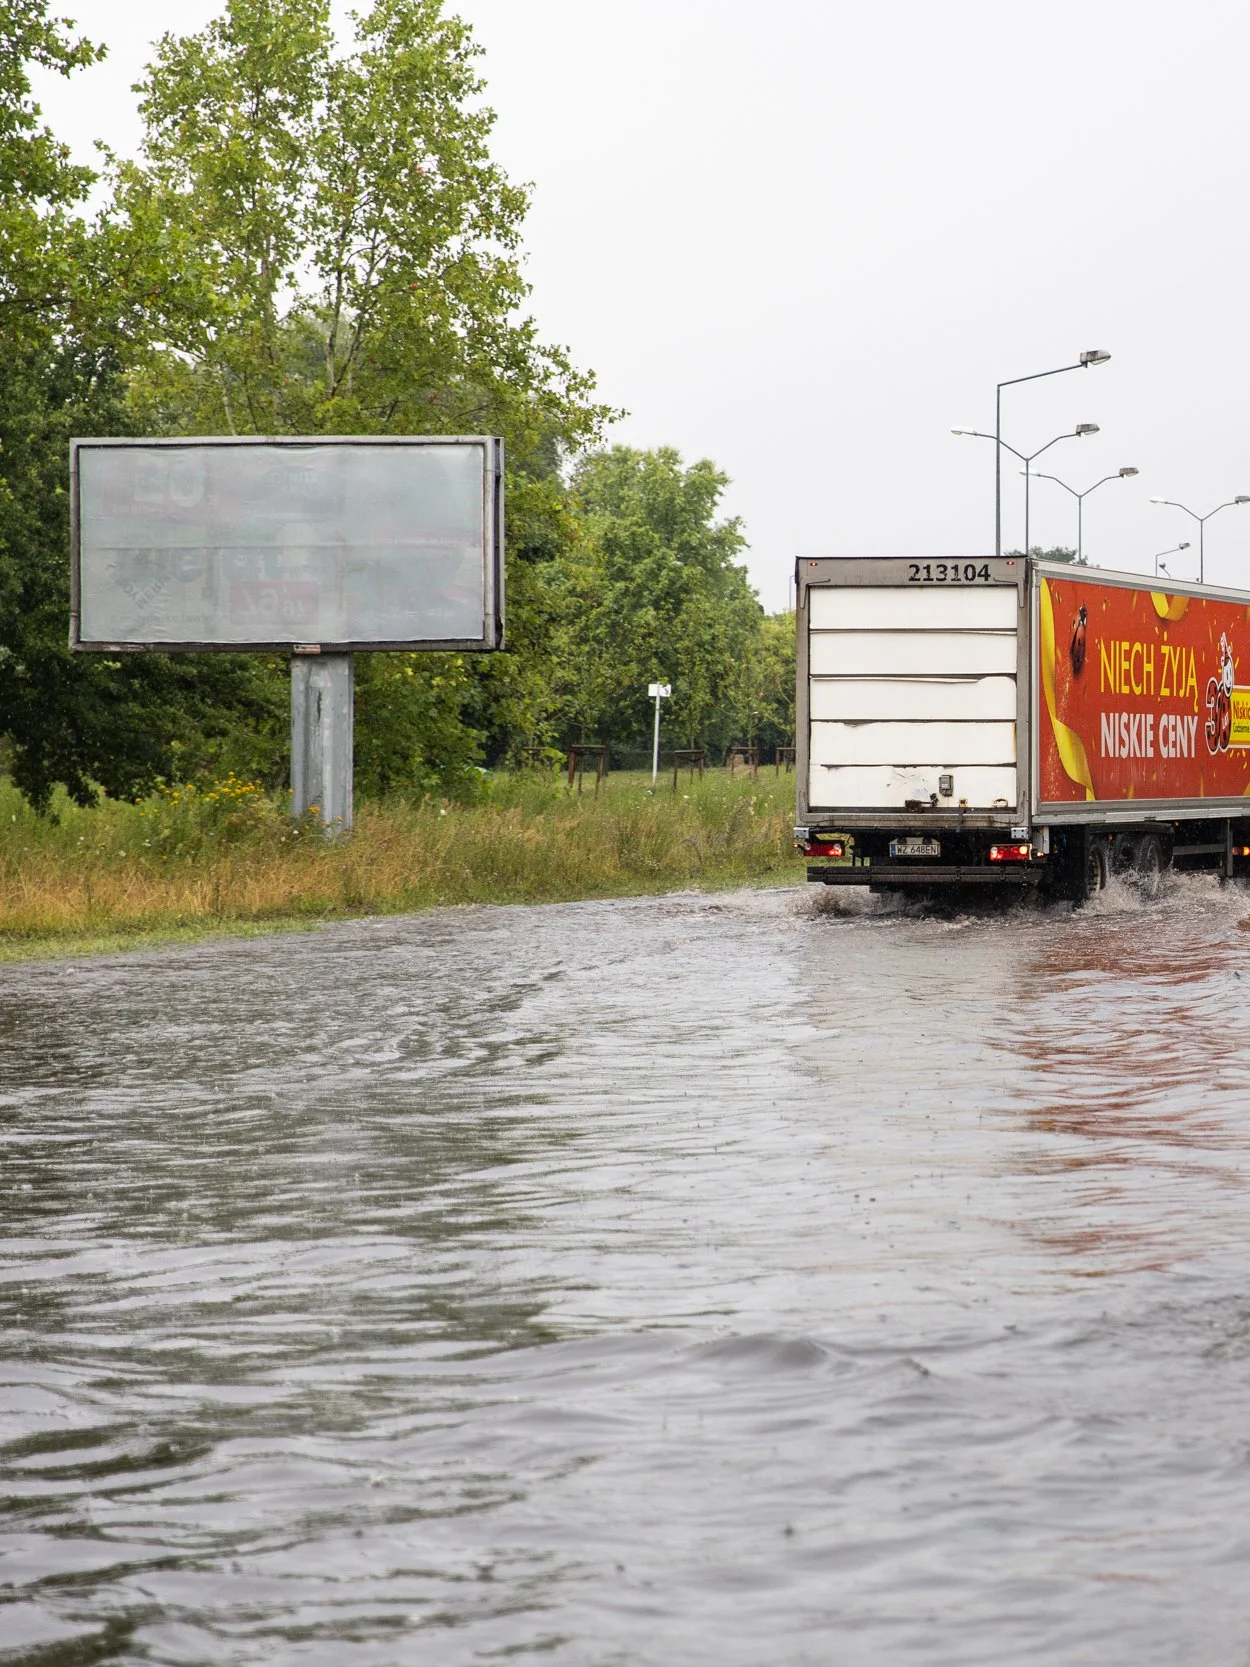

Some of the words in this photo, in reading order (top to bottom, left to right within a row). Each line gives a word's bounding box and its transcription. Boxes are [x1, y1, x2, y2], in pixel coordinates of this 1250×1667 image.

[908, 564, 991, 582] 213104
[1100, 636, 1154, 695] NIECH
[1160, 631, 1198, 713] ŻYJĄ
[1101, 712, 1154, 758] NISKIE
[1158, 713, 1198, 758] CENY
